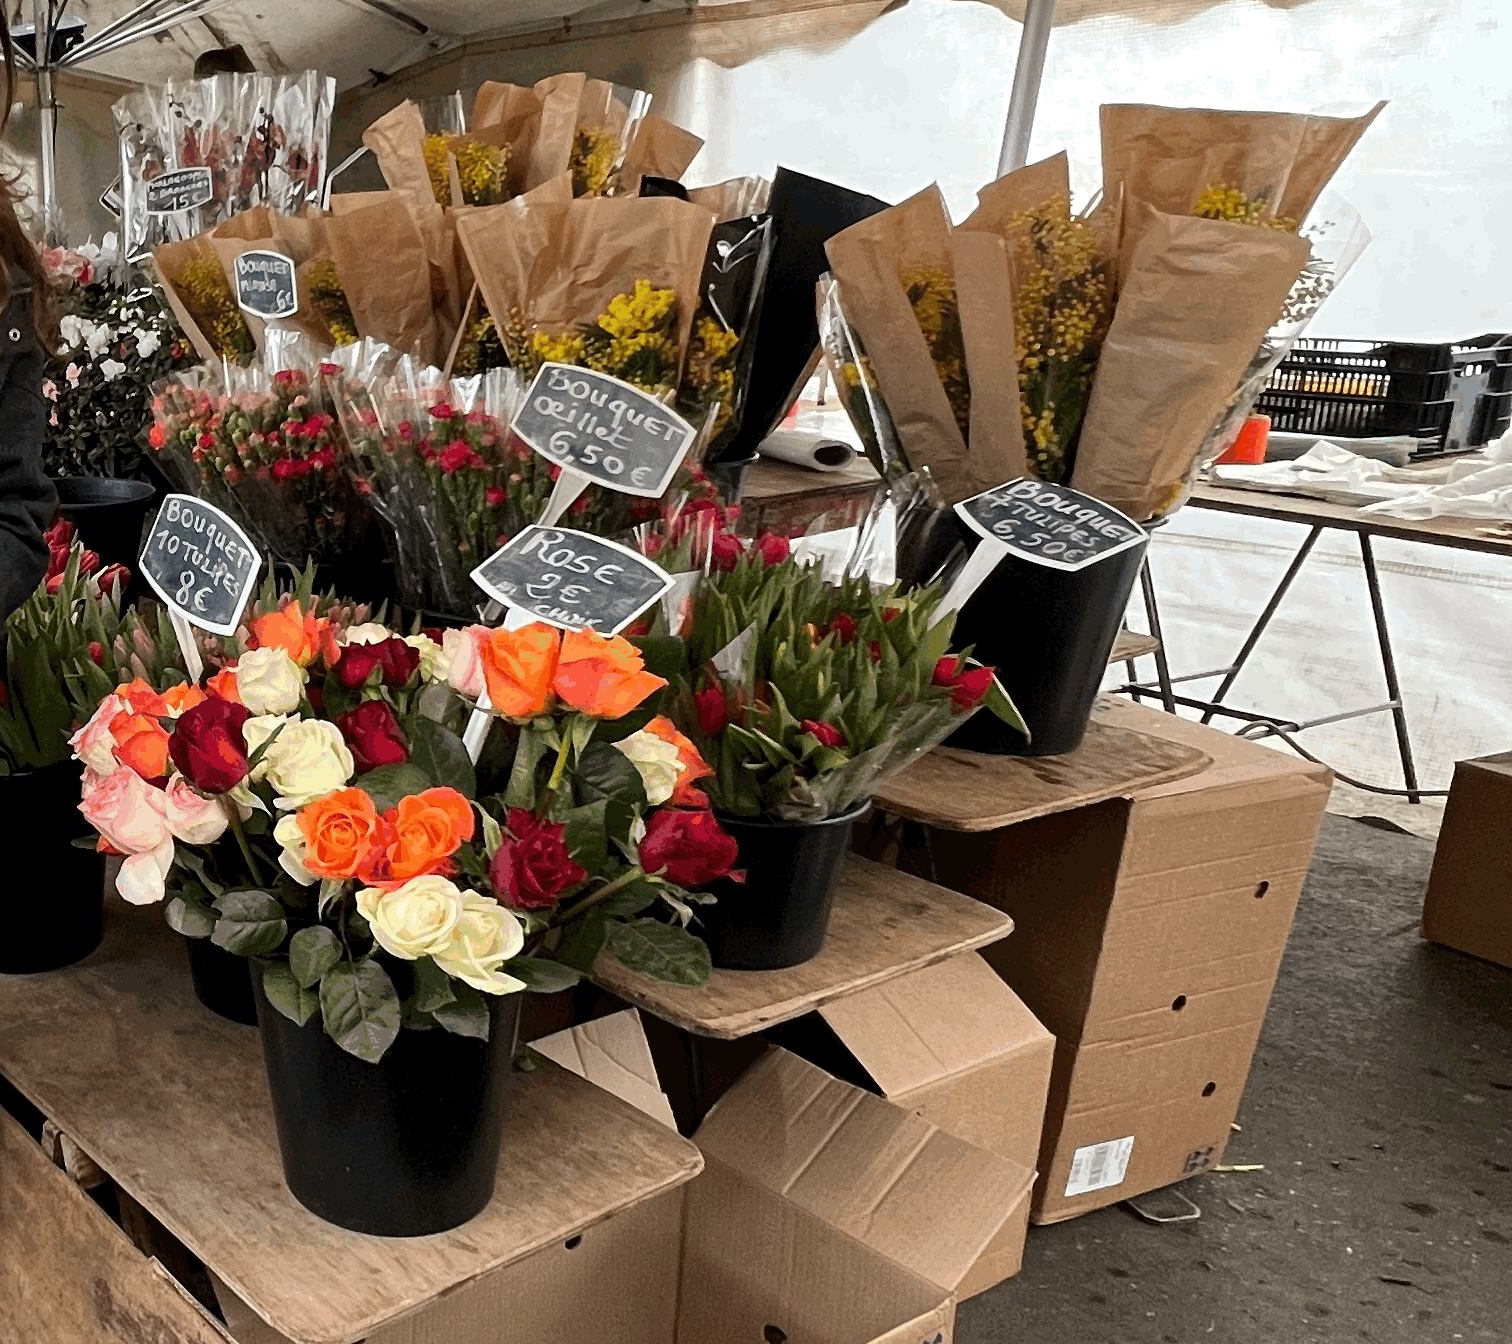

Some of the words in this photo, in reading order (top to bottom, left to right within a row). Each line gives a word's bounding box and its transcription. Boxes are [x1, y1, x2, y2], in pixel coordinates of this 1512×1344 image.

[519, 529, 625, 585] ROSE
[175, 569, 214, 612] 8€
[525, 572, 592, 604] 2€
